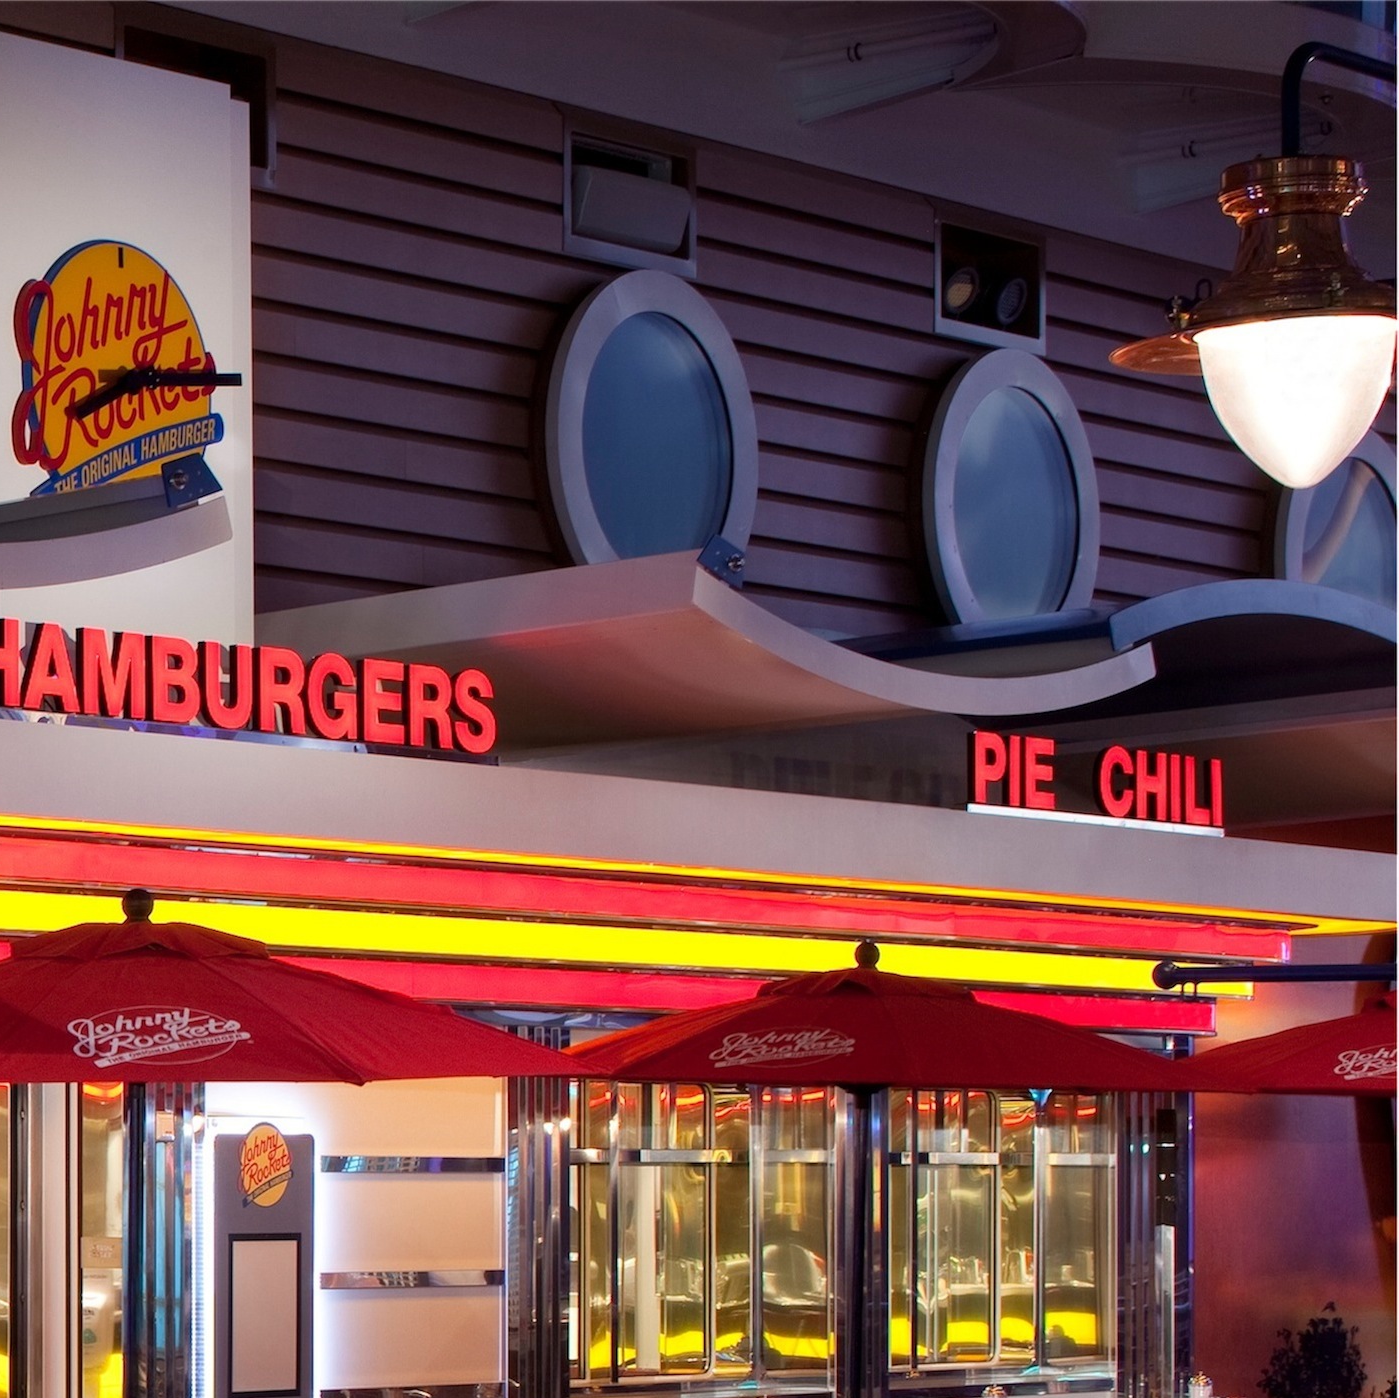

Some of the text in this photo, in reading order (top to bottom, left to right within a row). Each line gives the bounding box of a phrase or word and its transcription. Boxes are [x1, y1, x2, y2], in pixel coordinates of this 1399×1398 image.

[12, 271, 188, 464] Johnny
[81, 450, 137, 486] ORIGINAL
[140, 418, 216, 461] HAMBURGER
[971, 730, 1224, 827] PIE CHILI
[67, 1007, 209, 1058] Johnny
[98, 1018, 242, 1057] Rockets
[709, 1028, 839, 1060] Johnny
[237, 1132, 284, 1193] Johnny
[245, 1148, 293, 1194] Rockets
